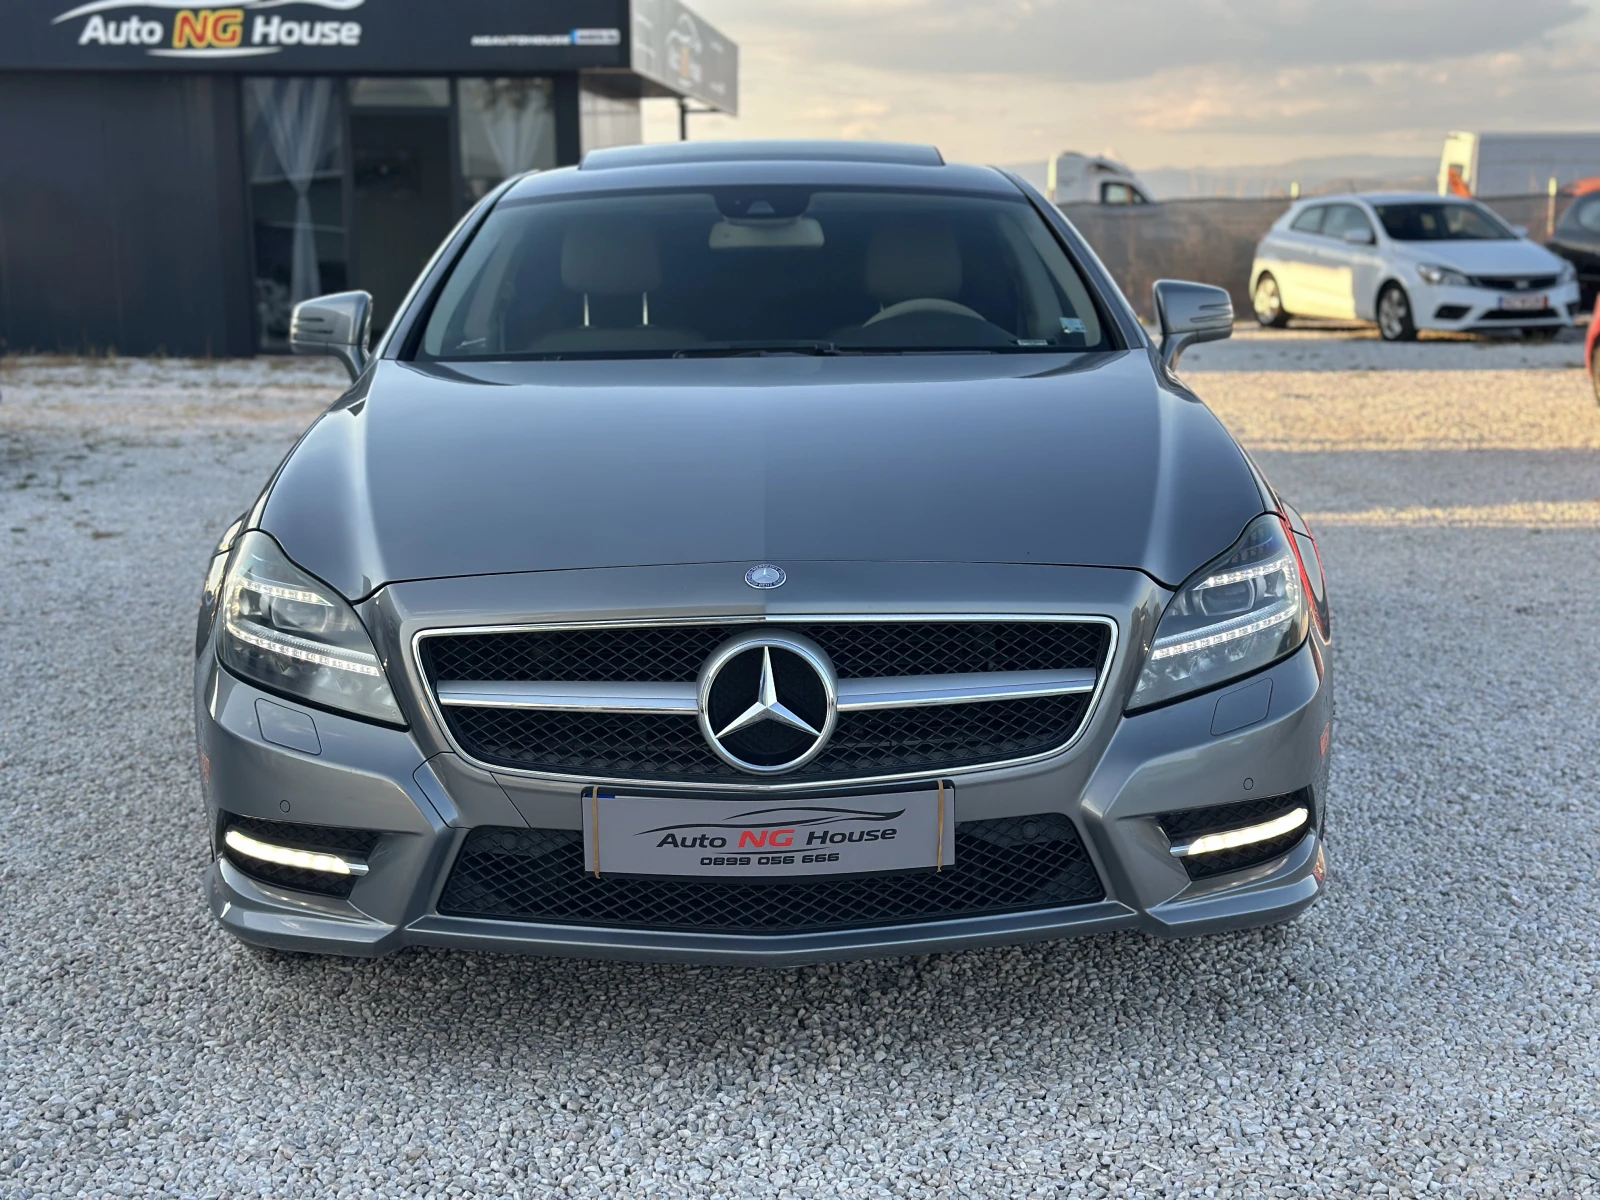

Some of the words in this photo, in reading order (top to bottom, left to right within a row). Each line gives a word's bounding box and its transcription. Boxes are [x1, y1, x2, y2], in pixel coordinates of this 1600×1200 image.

[78, 15, 164, 45] Auto
[173, 9, 244, 48] NG
[251, 15, 362, 45] House
[656, 833, 727, 848] Auto
[737, 829, 795, 848] NG
[806, 827, 898, 846] House
[700, 856, 751, 866] 0899
[757, 855, 795, 866] 056
[801, 852, 840, 864] 666
